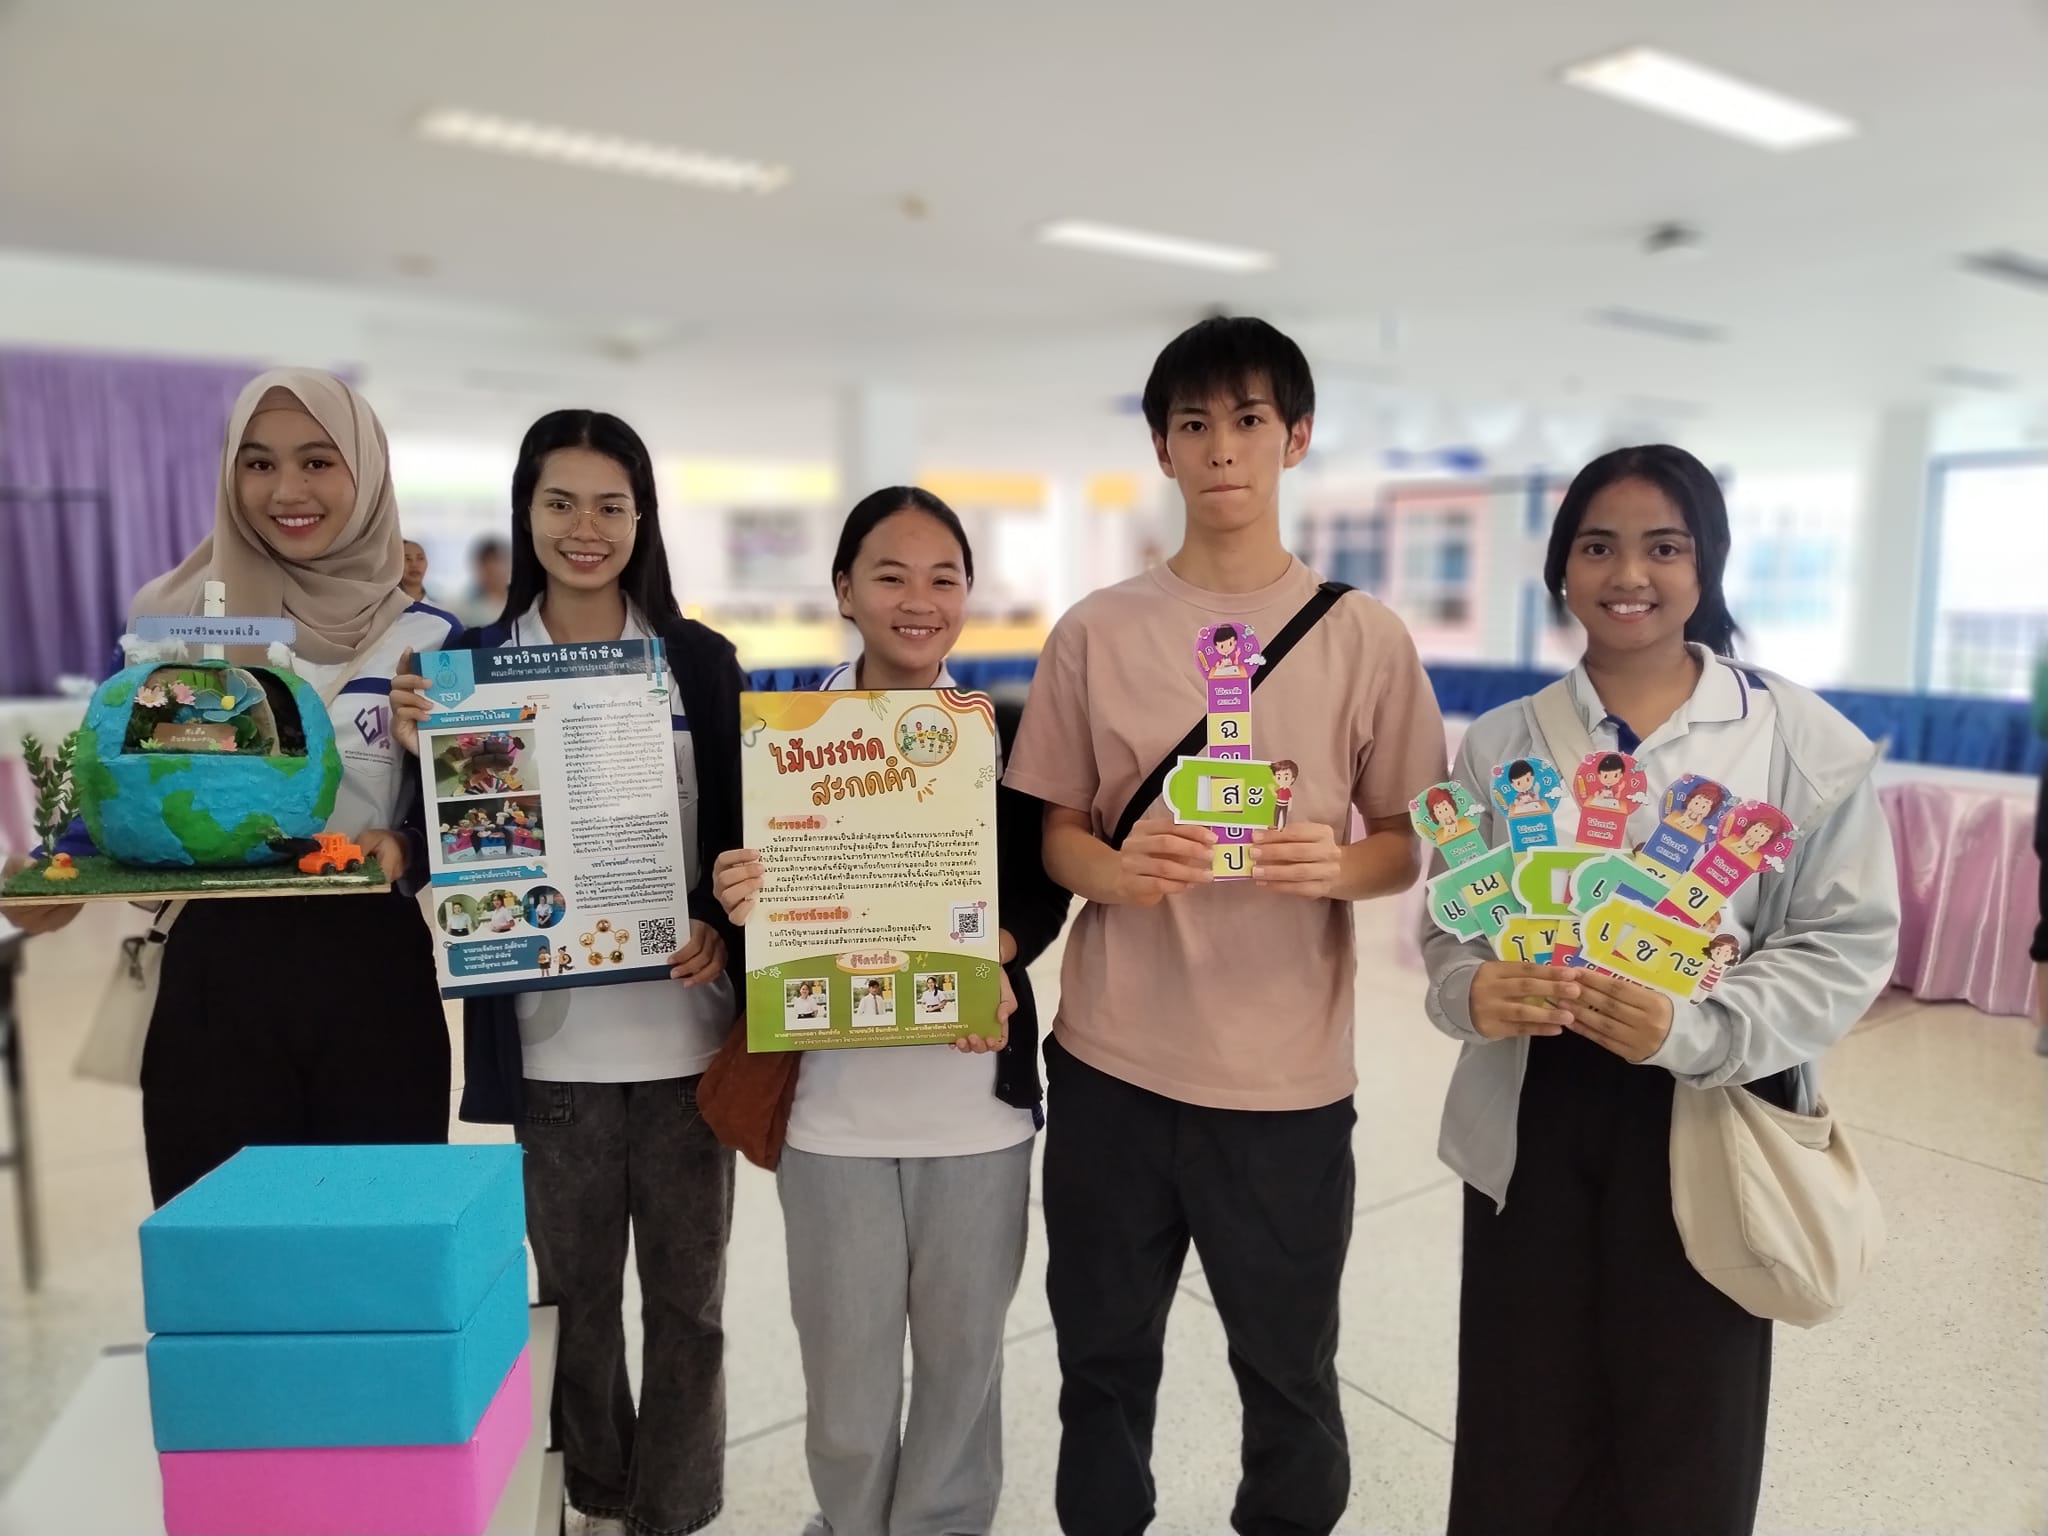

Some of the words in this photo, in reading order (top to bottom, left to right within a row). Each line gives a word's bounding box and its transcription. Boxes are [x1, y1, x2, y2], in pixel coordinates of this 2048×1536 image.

[493, 646, 624, 667] มหาวิทยาลัยทักษิณ
[439, 691, 462, 703] TSU
[1221, 720, 1238, 738] ฉ
[769, 728, 886, 775] ไม้บรรทัด
[811, 756, 917, 806] สะกดคำ
[768, 816, 821, 830] ที่มาของสื่อ
[1223, 845, 1244, 871] ป
[1688, 886, 1709, 909] ข
[769, 905, 849, 922] ประโยชน์ของสื่อ
[1443, 900, 1466, 921] แ
[850, 950, 898, 968] ผู้จัดทำสื่อ
